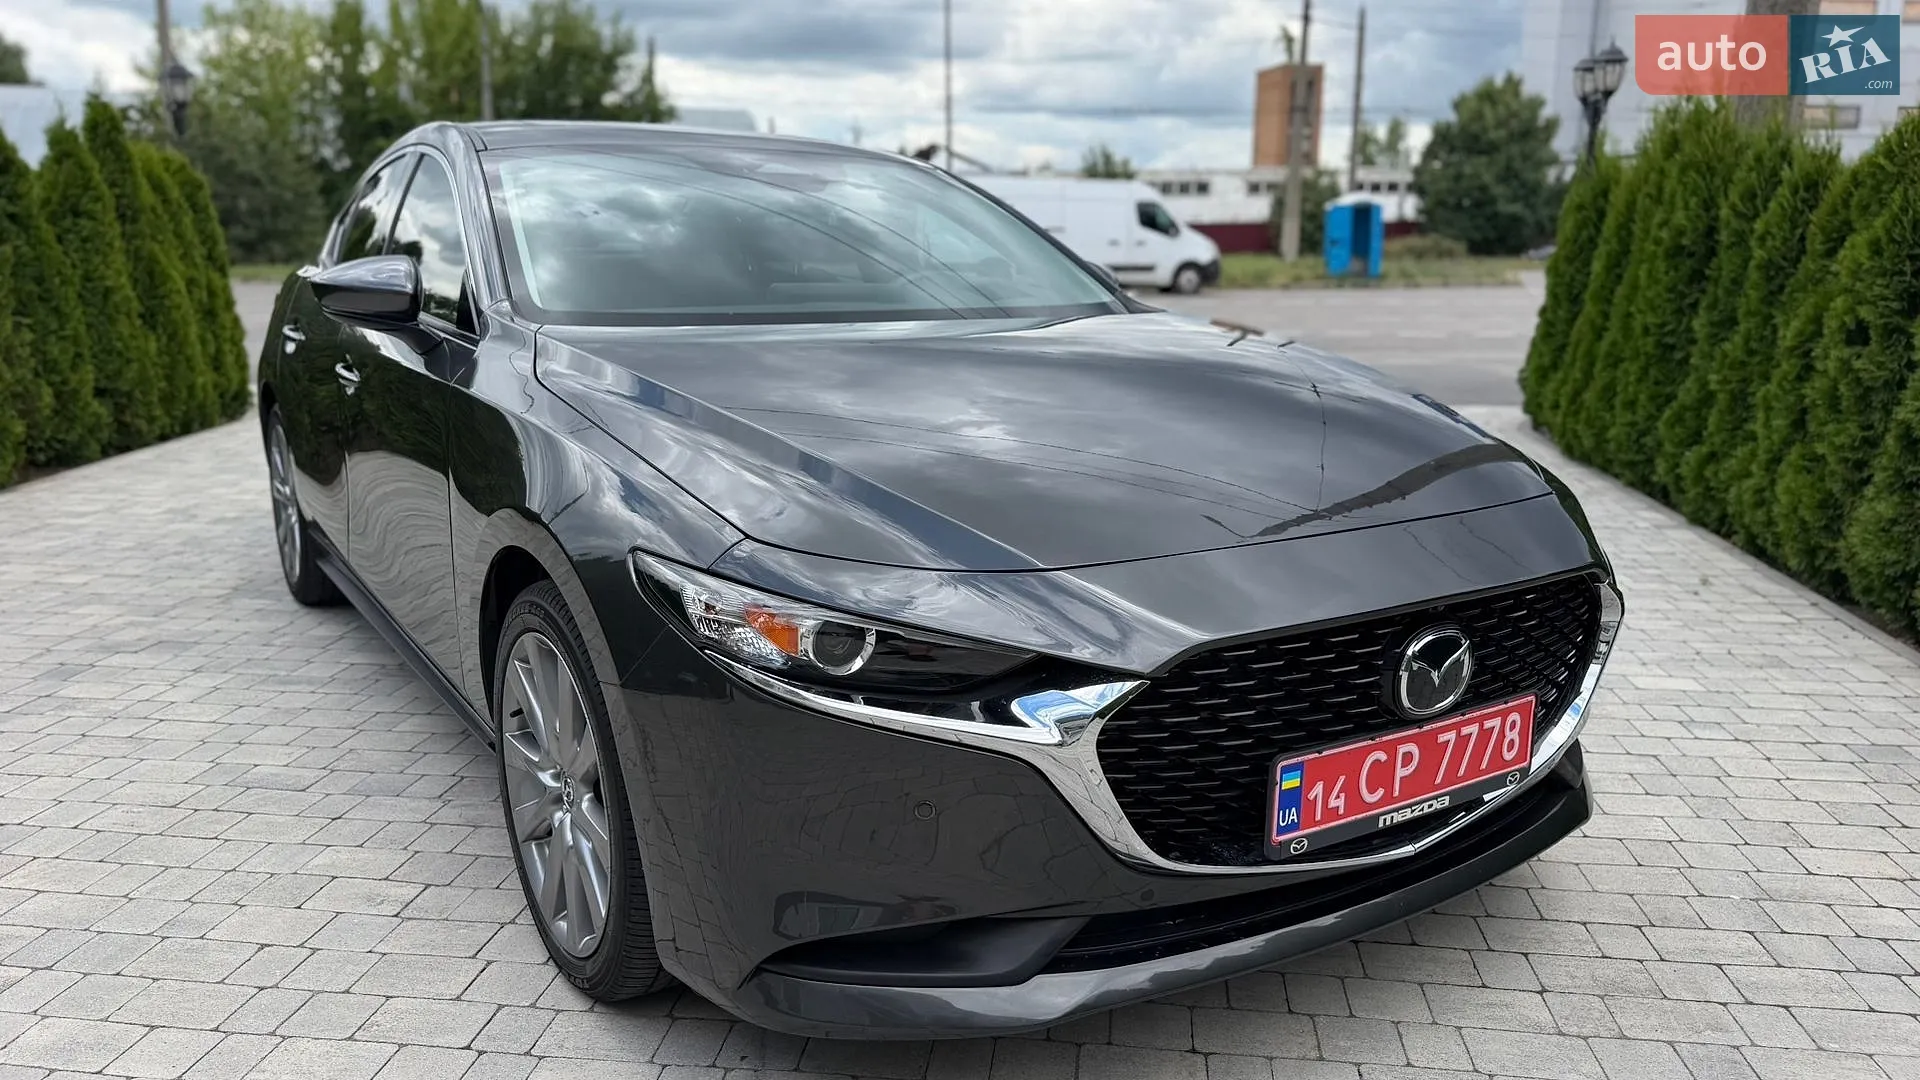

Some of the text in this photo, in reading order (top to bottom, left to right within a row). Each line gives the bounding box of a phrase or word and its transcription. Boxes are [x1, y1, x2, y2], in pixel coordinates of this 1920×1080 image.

[1307, 711, 1521, 821] 14 CP 7778
[1279, 806, 1298, 827] UA
